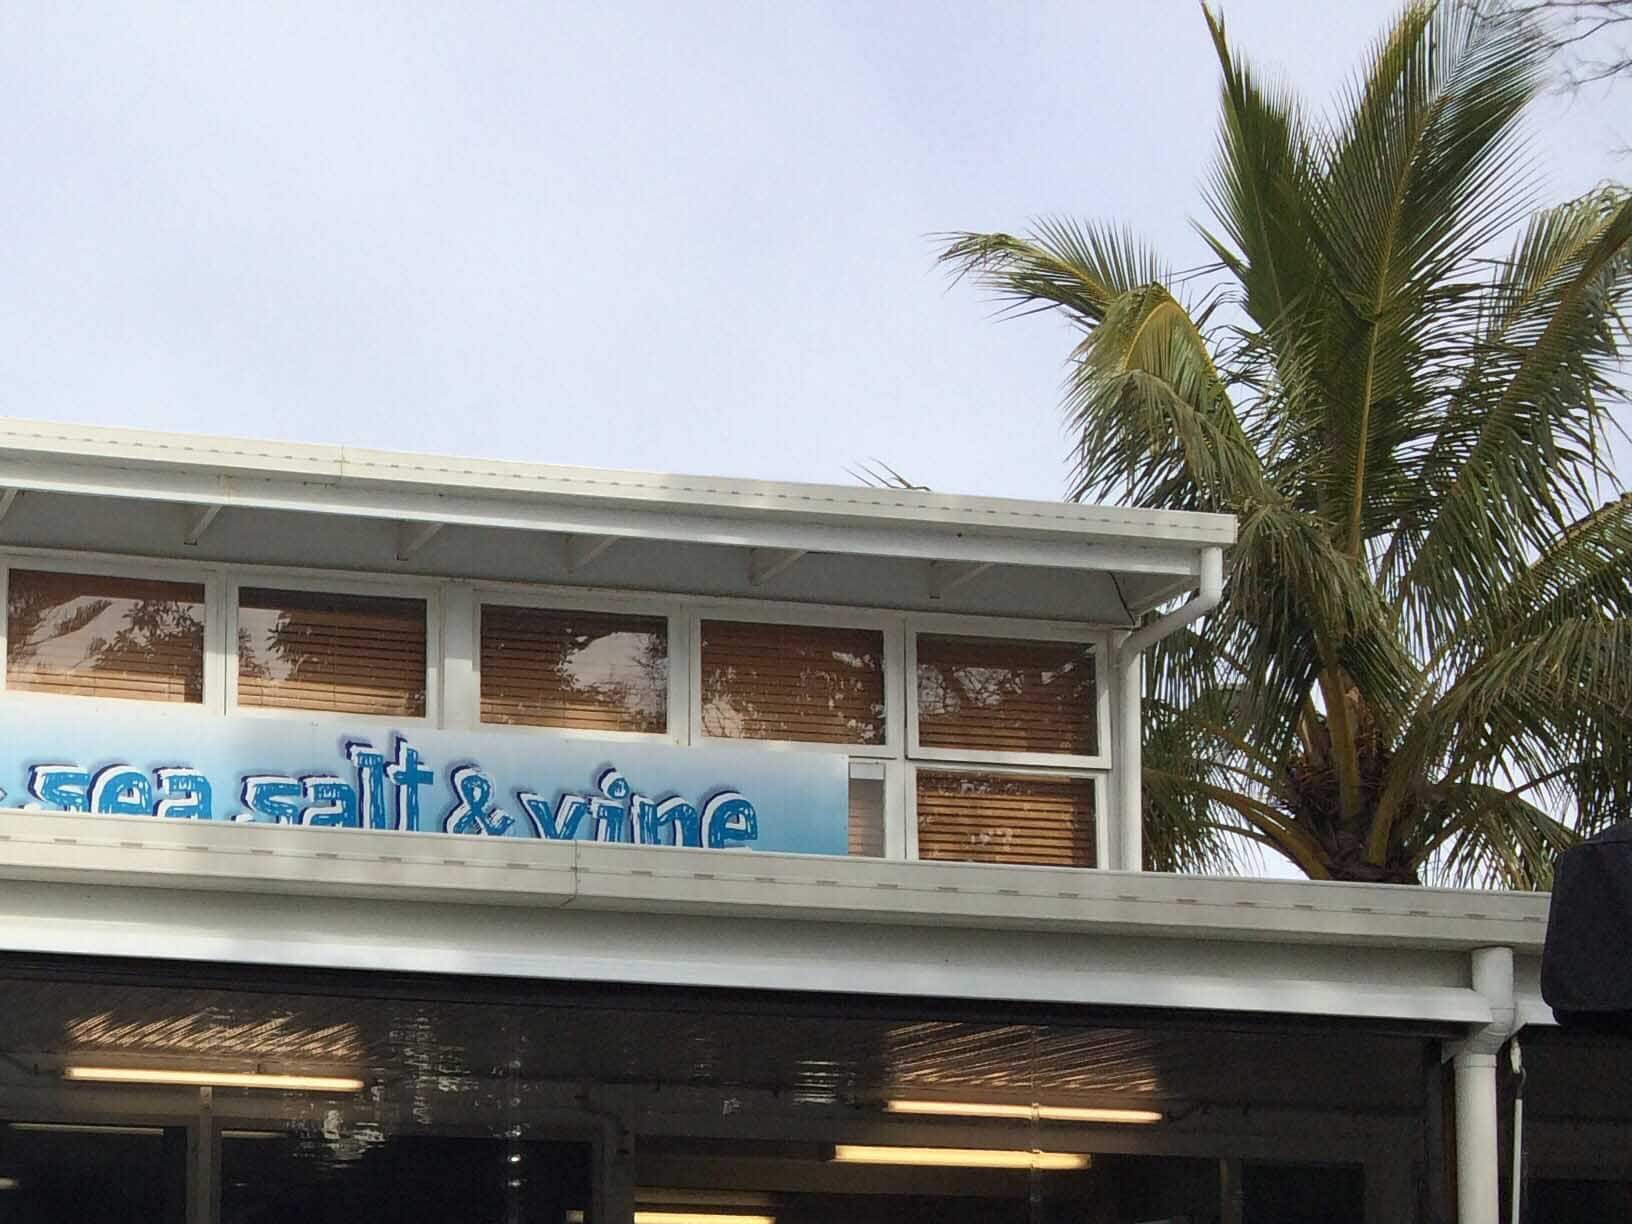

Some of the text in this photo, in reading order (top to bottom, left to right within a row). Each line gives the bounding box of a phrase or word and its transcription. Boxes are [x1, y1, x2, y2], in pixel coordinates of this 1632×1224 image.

[19, 736, 759, 850] sea salt & vine
